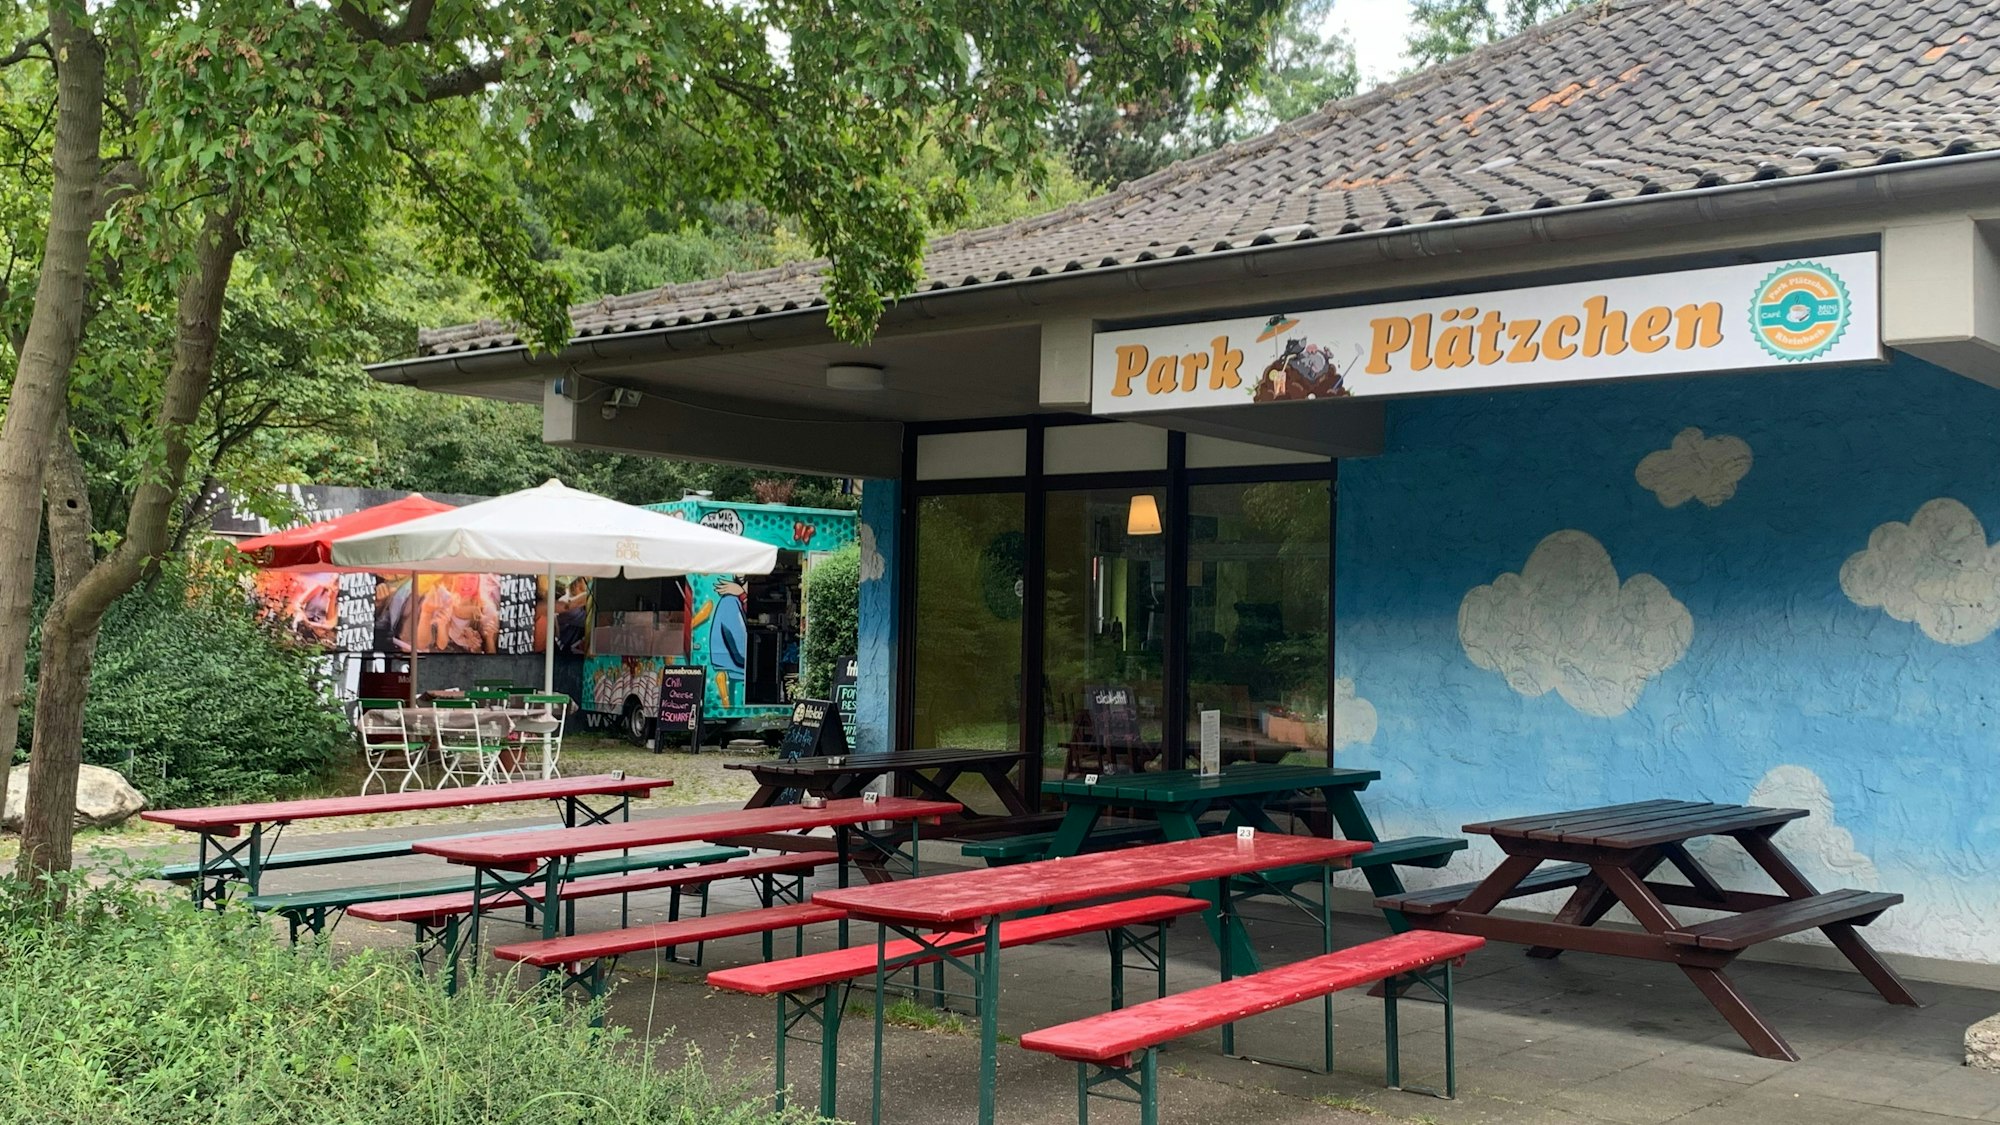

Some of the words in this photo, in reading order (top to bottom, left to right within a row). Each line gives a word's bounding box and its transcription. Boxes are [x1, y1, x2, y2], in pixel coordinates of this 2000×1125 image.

[1769, 281, 1788, 299] Park
[1775, 328, 1826, 345] Rheinbach
[1111, 336, 1244, 397] Park
[1365, 295, 1724, 374] Plätzchen
[1240, 829, 1251, 837] 23
